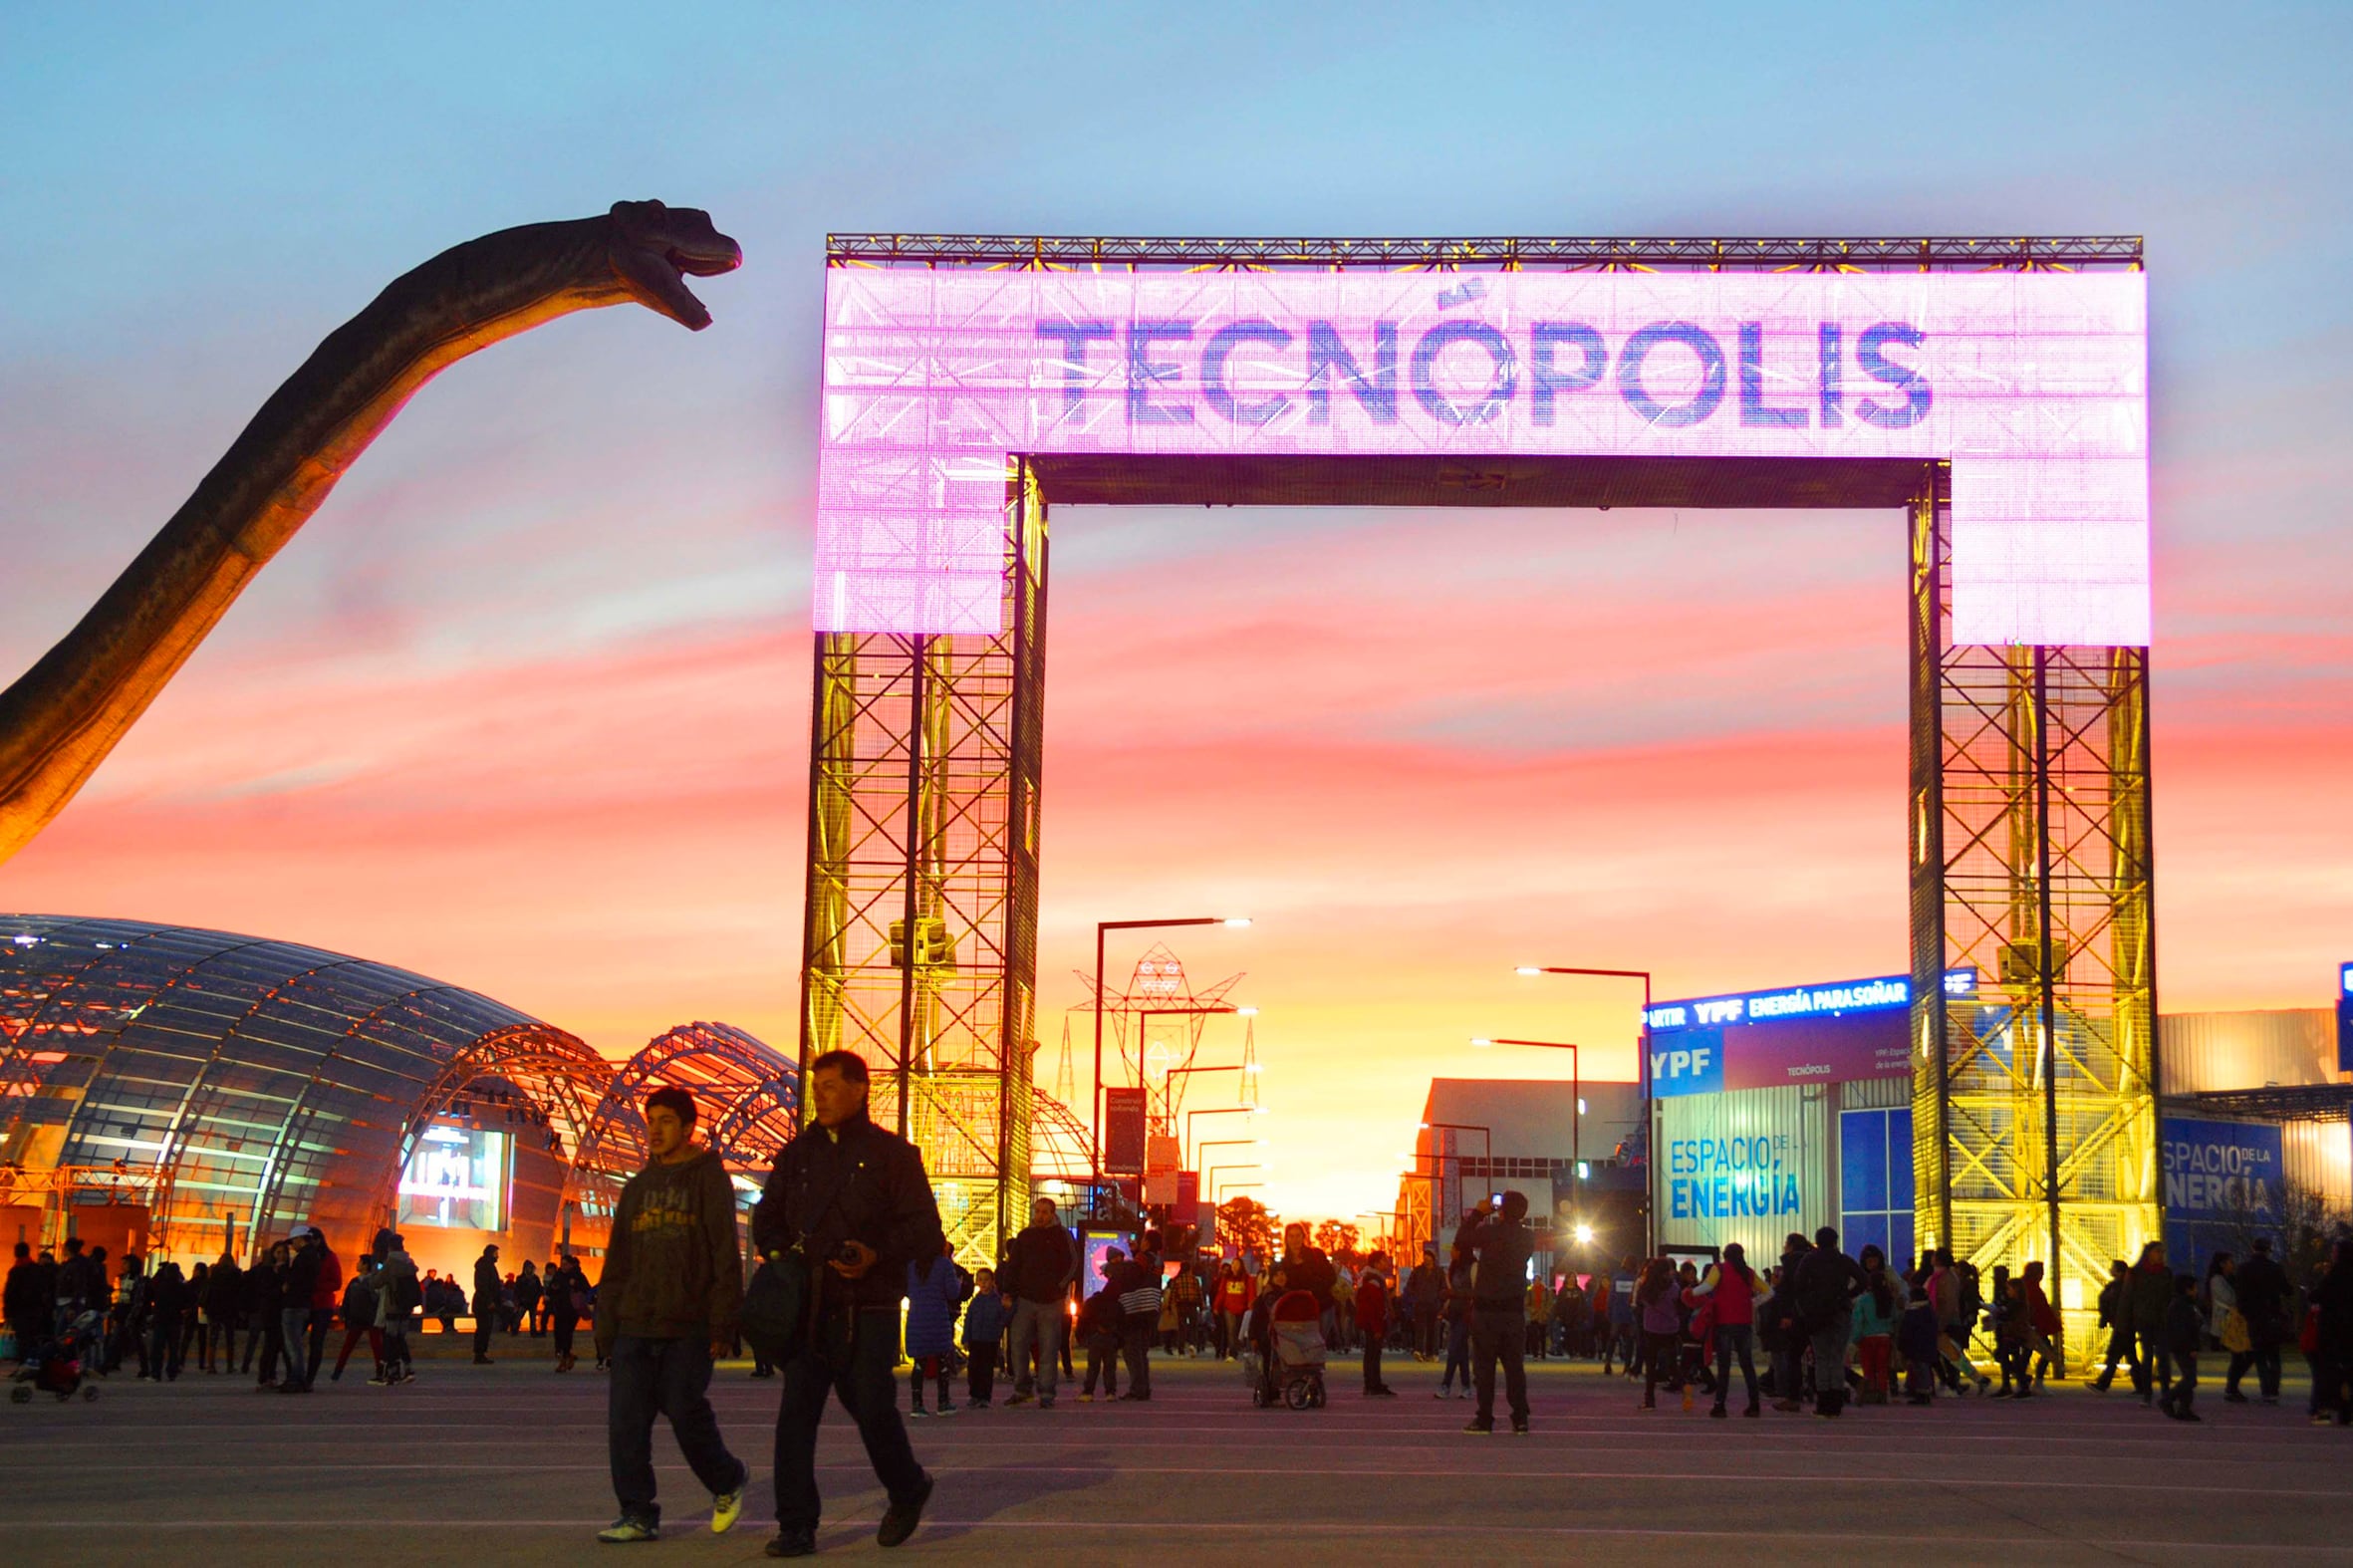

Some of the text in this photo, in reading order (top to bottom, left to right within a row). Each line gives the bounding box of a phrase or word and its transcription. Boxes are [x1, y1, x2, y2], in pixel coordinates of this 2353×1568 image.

[1035, 278, 1933, 428] TECNÓPOLIS
[1694, 999, 1742, 1024] YPF
[1749, 988, 1812, 1017] ENERGÍA
[1813, 989, 1854, 1010] PARA
[1853, 980, 1907, 1007] SOÑAR
[1650, 1048, 1710, 1080] YPF
[1787, 1063, 1830, 1076] TECNÓPOLIS
[1671, 1136, 1770, 1174] ESPACIO
[1773, 1135, 1788, 1150] DE
[2162, 1141, 2270, 1175] SPACIO DE LA
[1671, 1159, 1800, 1218] ENERGÍA
